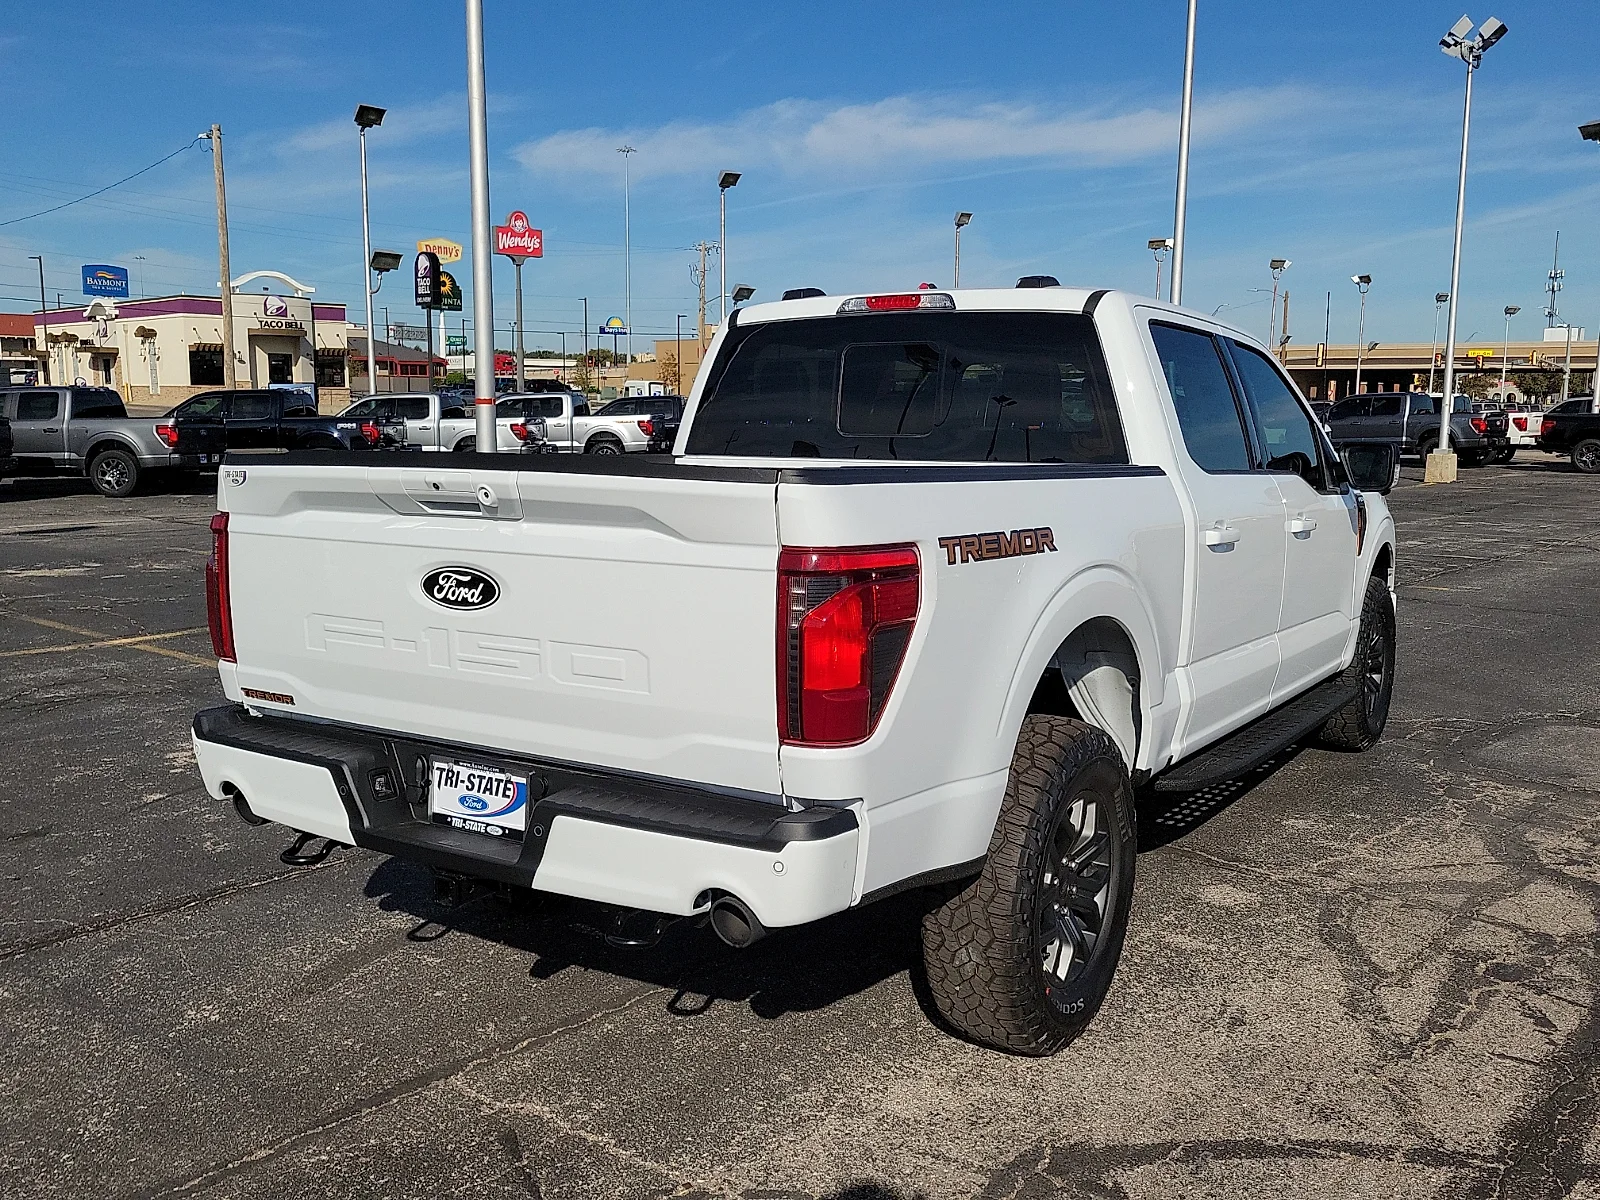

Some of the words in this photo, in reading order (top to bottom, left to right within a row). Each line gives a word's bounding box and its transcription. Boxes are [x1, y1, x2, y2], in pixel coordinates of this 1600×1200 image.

[424, 244, 460, 258] Denny's
[498, 232, 541, 252] Wendy's
[86, 277, 127, 287] BAYMONT
[416, 278, 431, 286] TACO
[417, 286, 431, 294] BELL
[258, 320, 284, 329] TACO
[284, 321, 306, 330] BELL
[938, 526, 1059, 566] TREMOR
[433, 572, 485, 604] Ford
[303, 612, 652, 695] F-150
[240, 687, 296, 706] TREMOR
[435, 766, 513, 800] TRI-STATE
[451, 817, 487, 834] TRI-STATE
